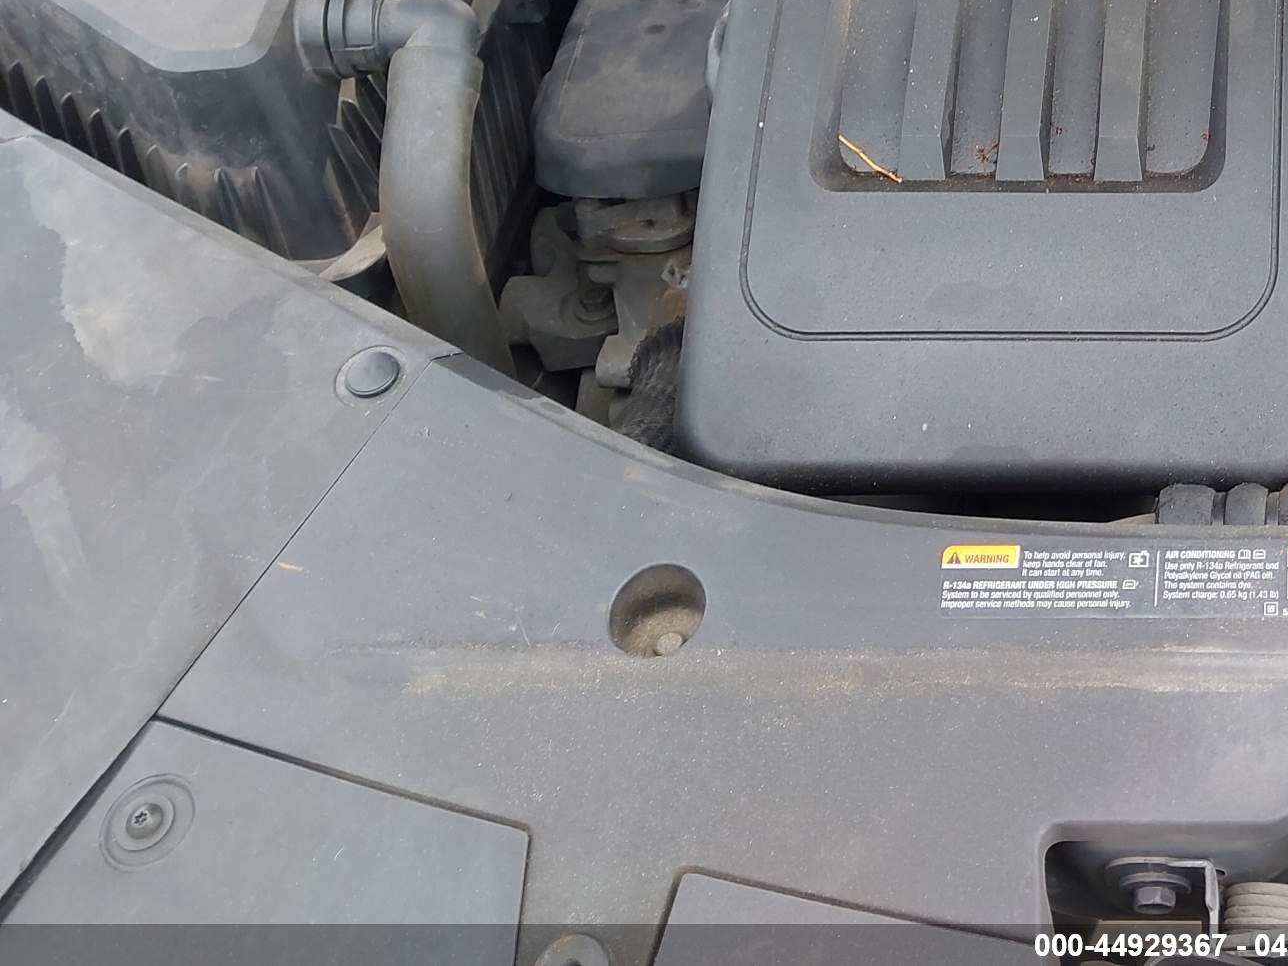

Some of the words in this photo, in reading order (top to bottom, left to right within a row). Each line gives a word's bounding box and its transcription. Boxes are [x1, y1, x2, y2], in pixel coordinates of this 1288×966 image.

[964, 553, 1009, 564] WARNING
[1023, 550, 1033, 561] To
[1034, 550, 1050, 561] help
[1051, 550, 1070, 561] avoid
[1072, 550, 1103, 561] personal
[1165, 550, 1178, 559] AIR
[1180, 550, 1235, 559] CONDITIONING
[1023, 560, 1041, 568] keep
[1042, 560, 1064, 568] hands
[1066, 560, 1083, 568] clear
[1085, 560, 1092, 568] of
[1164, 561, 1178, 570] Use
[1180, 561, 1194, 570] only
[1196, 561, 1224, 570] R-134a
[1224, 561, 1264, 570] Refrigerant
[1266, 561, 1280, 570] and
[1022, 569, 1028, 577] It
[1028, 569, 1041, 577] can
[1044, 569, 1060, 577] start
[1062, 569, 1070, 577] at
[1071, 569, 1084, 577] any
[1164, 571, 1208, 580] Polyalkylene
[1209, 571, 1231, 580] Glycol
[1232, 571, 1242, 580] oil
[1244, 571, 1260, 580] (PAG
[943, 580, 972, 589] R-134a
[972, 580, 1027, 589] REFRIGERANT
[1028, 580, 1055, 589] UNDER
[1056, 580, 1076, 589] HIGH
[1076, 580, 1118, 589] PRESSURE
[1164, 581, 1178, 590] The
[1179, 581, 1205, 590] system
[1206, 581, 1237, 590] contains
[942, 590, 969, 600] System
[971, 590, 978, 600] to
[980, 590, 990, 600] be
[990, 590, 1021, 600] serviced
[1022, 590, 1033, 600] by
[1034, 590, 1065, 600] qualified
[1066, 590, 1102, 600] personnel
[1163, 590, 1190, 600] System
[1192, 590, 1218, 600] charge:
[1238, 590, 1248, 600] kg
[1269, 590, 1280, 600] lb)
[940, 600, 974, 609] Improper
[975, 600, 1002, 609] service
[1003, 600, 1034, 609] methods
[1036, 600, 1052, 609] may
[1054, 600, 1076, 609] cause
[1076, 600, 1108, 609] personal
